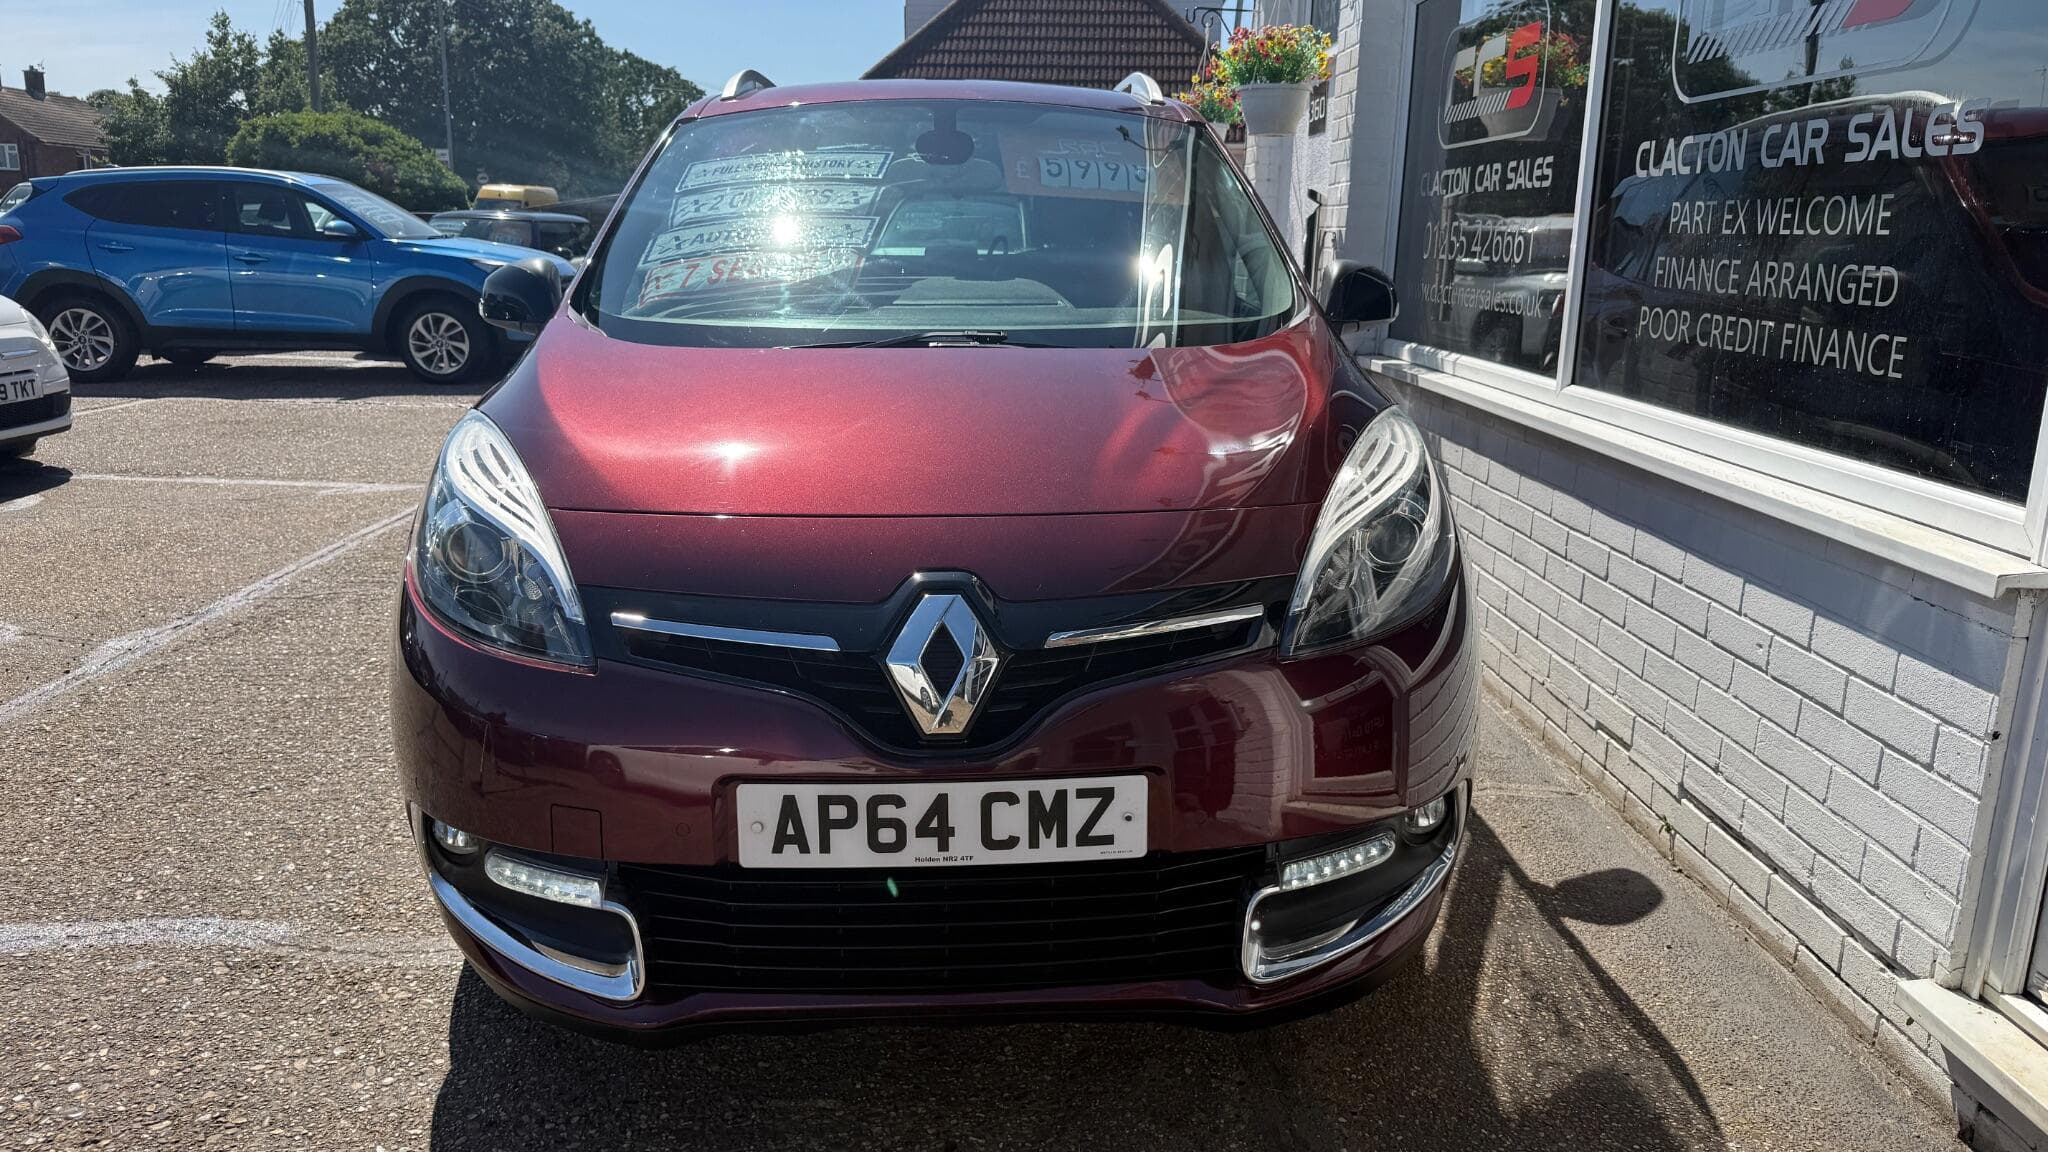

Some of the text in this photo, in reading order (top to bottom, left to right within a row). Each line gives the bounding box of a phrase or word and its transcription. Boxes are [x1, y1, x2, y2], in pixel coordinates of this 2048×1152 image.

[1636, 98, 1989, 178] CLACTON CAR SALES
[1420, 155, 1554, 197] CLACTON CAR SALES
[1668, 193, 1895, 235] PART EX WELCOME
[1471, 218, 1536, 263] 426661
[1655, 256, 1899, 307] FINANCE ARRANGED
[1638, 305, 1908, 379] POOR CREDIT FINANCE
[10, 378, 36, 399] TKT
[771, 786, 1116, 855] AP64 CMZ
